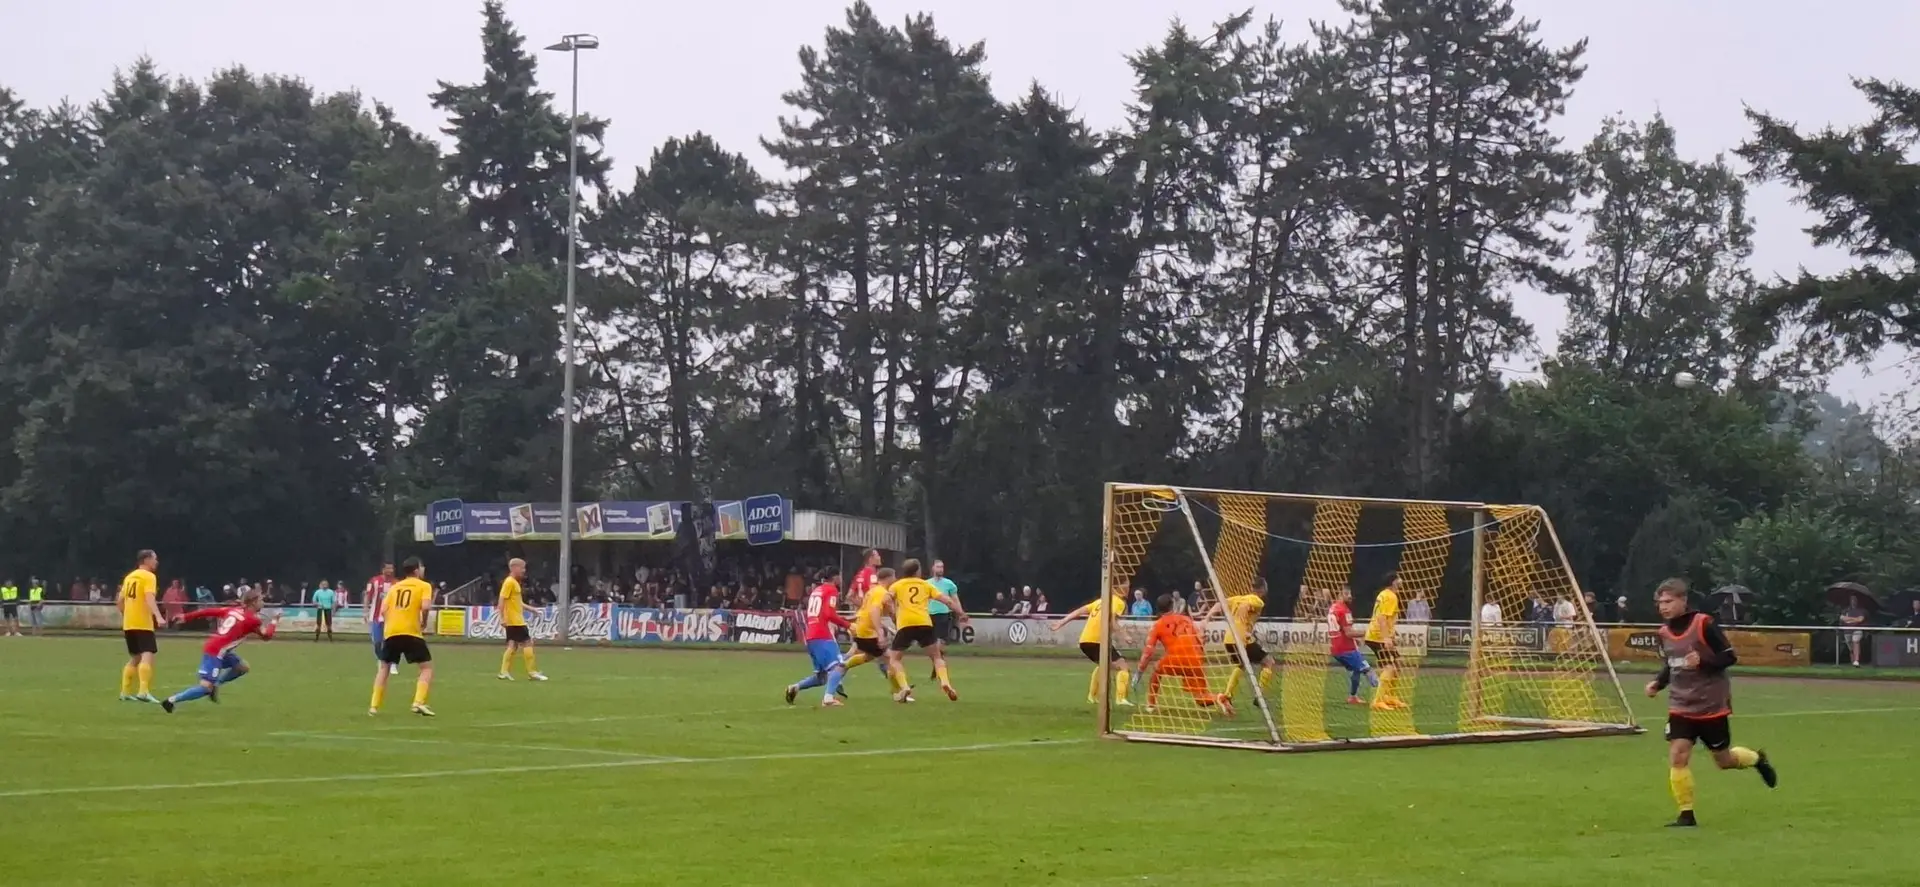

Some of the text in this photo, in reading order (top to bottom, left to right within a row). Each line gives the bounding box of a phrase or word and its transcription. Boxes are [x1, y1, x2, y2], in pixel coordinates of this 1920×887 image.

[435, 508, 462, 521] ADCO
[749, 505, 781, 520] ADCO
[126, 581, 137, 600] 14
[908, 587, 919, 604] 2
[395, 589, 412, 609] 10
[1907, 638, 1918, 653] H
